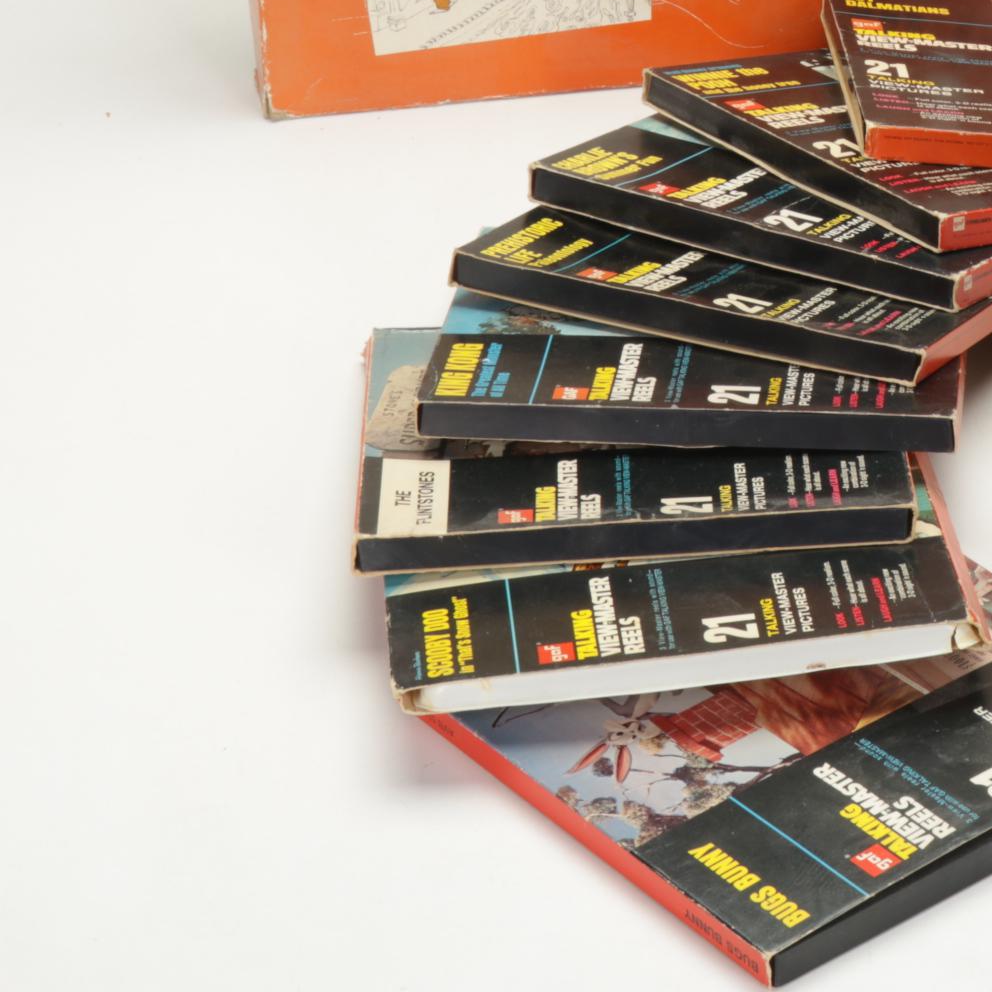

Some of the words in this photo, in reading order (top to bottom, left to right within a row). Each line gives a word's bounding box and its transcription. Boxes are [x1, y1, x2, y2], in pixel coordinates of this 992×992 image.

[845, 0, 951, 15] DALMATIANS
[853, 29, 936, 40] TALKING
[856, 41, 918, 52] REELS
[864, 59, 910, 79] 21
[866, 74, 935, 86] TALKING
[868, 79, 984, 94] VIEW-MASTER
[870, 84, 952, 96] PICTURES
[743, 103, 820, 117] TALKING
[768, 116, 825, 129] REELS
[812, 138, 862, 158] 21
[763, 209, 823, 232] 21
[807, 213, 853, 236] TALKING
[480, 217, 564, 258] PREHISTORIC
[504, 249, 543, 264] LIFE
[606, 261, 662, 284] TALKING
[712, 293, 773, 314] 21
[759, 298, 801, 320] TALKING
[444, 343, 485, 371] KONG
[435, 371, 474, 397] KING
[588, 367, 616, 401] TALKING
[609, 343, 644, 401] VIEW-MASTER
[631, 376, 657, 402] REELS
[707, 384, 761, 405] 21
[765, 377, 783, 406] TALKING
[799, 372, 815, 406] PICTURES
[395, 489, 412, 507] THE
[416, 471, 435, 525] FLINTSTONES
[557, 459, 578, 520] VIEW-MASTER
[719, 484, 732, 512] TALKING
[734, 462, 750, 512] VIEW-MASTER
[752, 476, 767, 510] PICTURES
[534, 486, 557, 522] TALKING
[580, 494, 602, 519] REELS
[660, 496, 713, 515] 21
[588, 575, 622, 657] VIEW-MASTER
[760, 598, 780, 638] TALKING
[771, 572, 797, 636] VIEW-MASTER
[792, 587, 815, 633] PICTURES
[422, 608, 449, 633] DOO
[571, 609, 599, 660] TALKING
[702, 612, 760, 643] 21
[619, 615, 646, 655] REELS
[424, 635, 455, 678] SCOOBY
[544, 645, 568, 661] gaf
[902, 765, 931, 785] TALKING
[812, 762, 935, 850] VIEW-MASTER
[894, 795, 957, 840] REELS
[839, 803, 919, 861] TALKING
[688, 842, 762, 892] BUNNY
[856, 852, 893, 870] gaf
[750, 885, 811, 928] BUGS
[684, 909, 723, 946] BUNNY
[726, 942, 759, 974] BUGS
